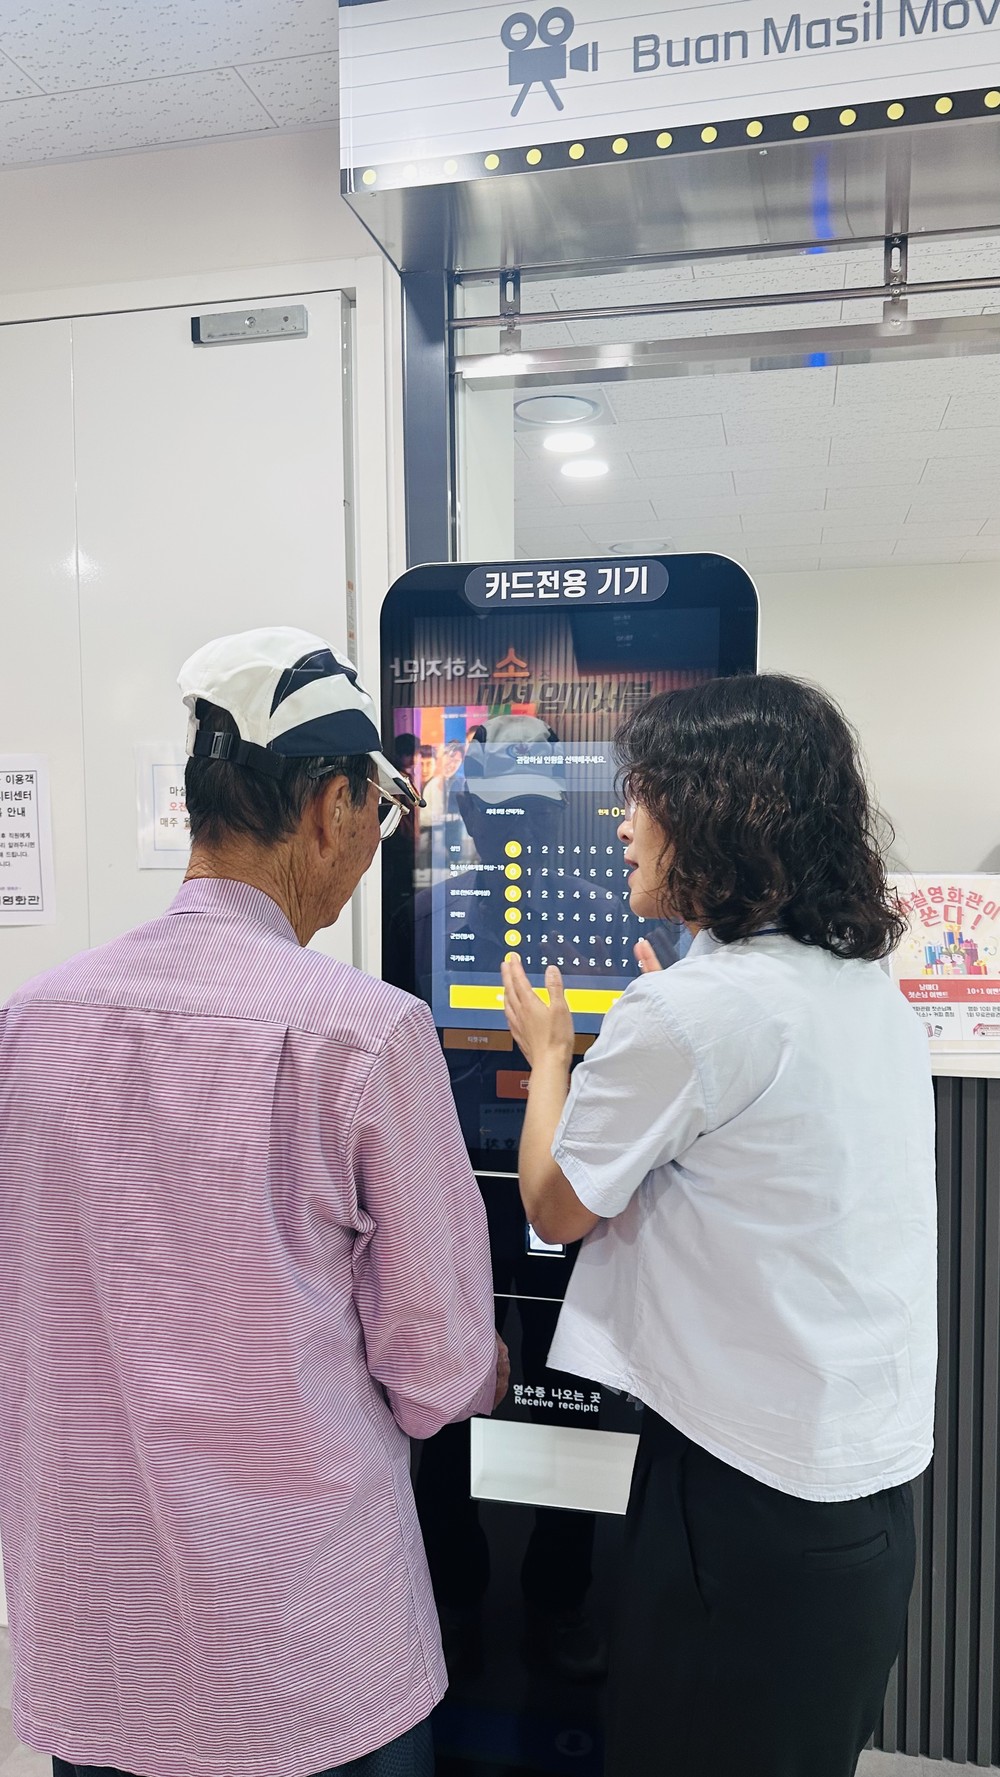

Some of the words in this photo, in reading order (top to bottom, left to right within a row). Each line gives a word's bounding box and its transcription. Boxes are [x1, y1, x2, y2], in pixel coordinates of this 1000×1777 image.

[632, 28, 748, 73] Buan
[763, 0, 883, 55] Masil
[485, 569, 587, 600] 카드전용
[597, 566, 649, 596] 기기
[6, 774, 34, 785] 이용객
[7, 807, 26, 817] 안내
[159, 817, 179, 828] 매주
[558, 846, 565, 854] 3
[590, 846, 597, 854] 5
[606, 846, 614, 854] 6
[542, 868, 549, 876] 2
[606, 869, 613, 877] 6
[623, 869, 630, 877] 7
[542, 890, 549, 898] 2
[590, 891, 597, 899] 5
[558, 913, 565, 921] 3
[573, 913, 581, 921] 4
[606, 914, 613, 922] 6
[622, 914, 629, 922] 7
[557, 935, 565, 943] 3
[589, 936, 596, 944] 5
[557, 957, 564, 965] 3
[589, 958, 596, 966] 5
[622, 959, 629, 967] 7
[513, 1384, 546, 1398] 영수증
[551, 1388, 585, 1402] 나오는
[590, 1392, 602, 1404] 곳
[514, 1396, 554, 1409] Receive
[558, 1400, 599, 1413] receipts
